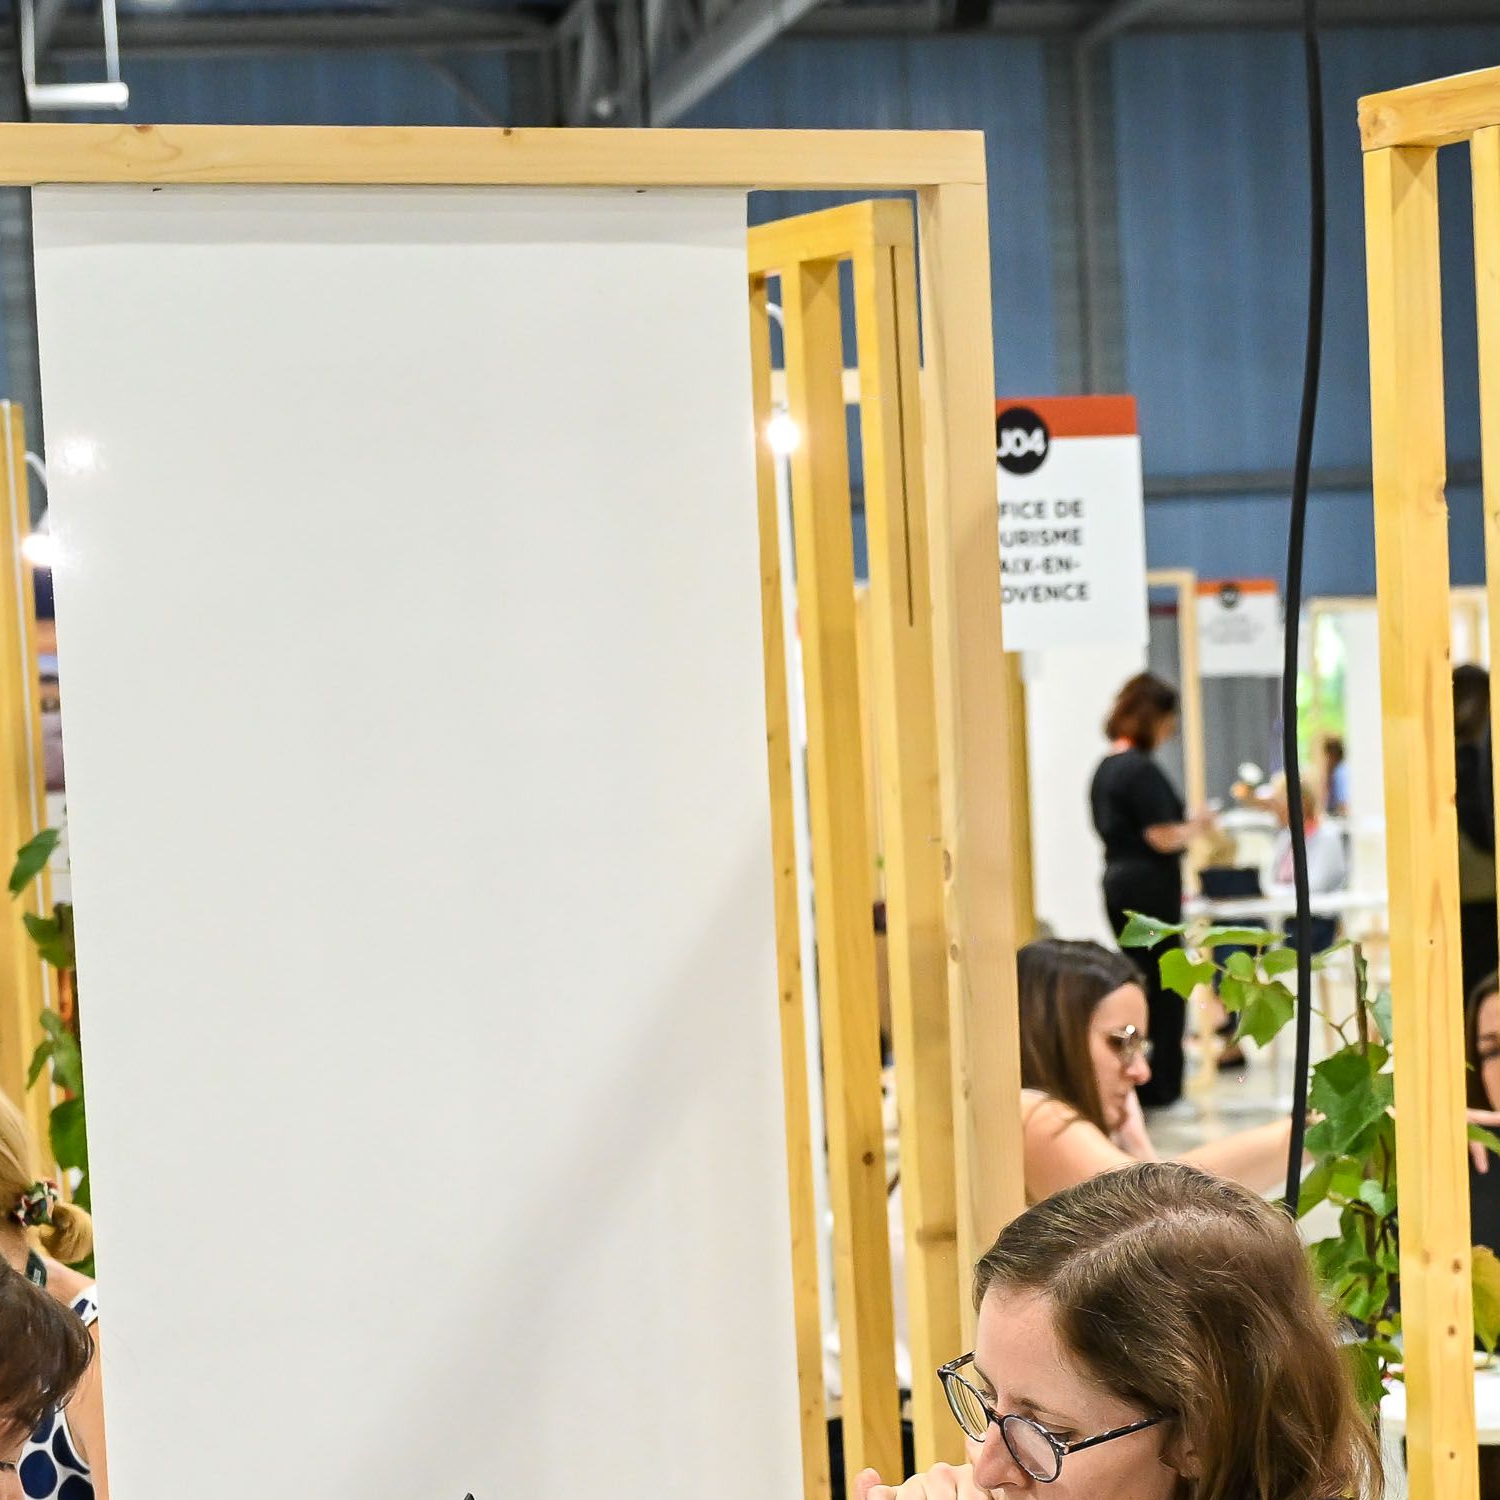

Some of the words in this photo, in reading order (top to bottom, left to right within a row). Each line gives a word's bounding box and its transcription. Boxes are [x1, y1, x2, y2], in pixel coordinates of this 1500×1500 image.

[997, 428, 1046, 457] J04
[1000, 500, 1044, 519] FICE
[1055, 499, 1084, 519] DE
[1000, 529, 1082, 548] URISME
[1001, 582, 1091, 603] OVENCE
